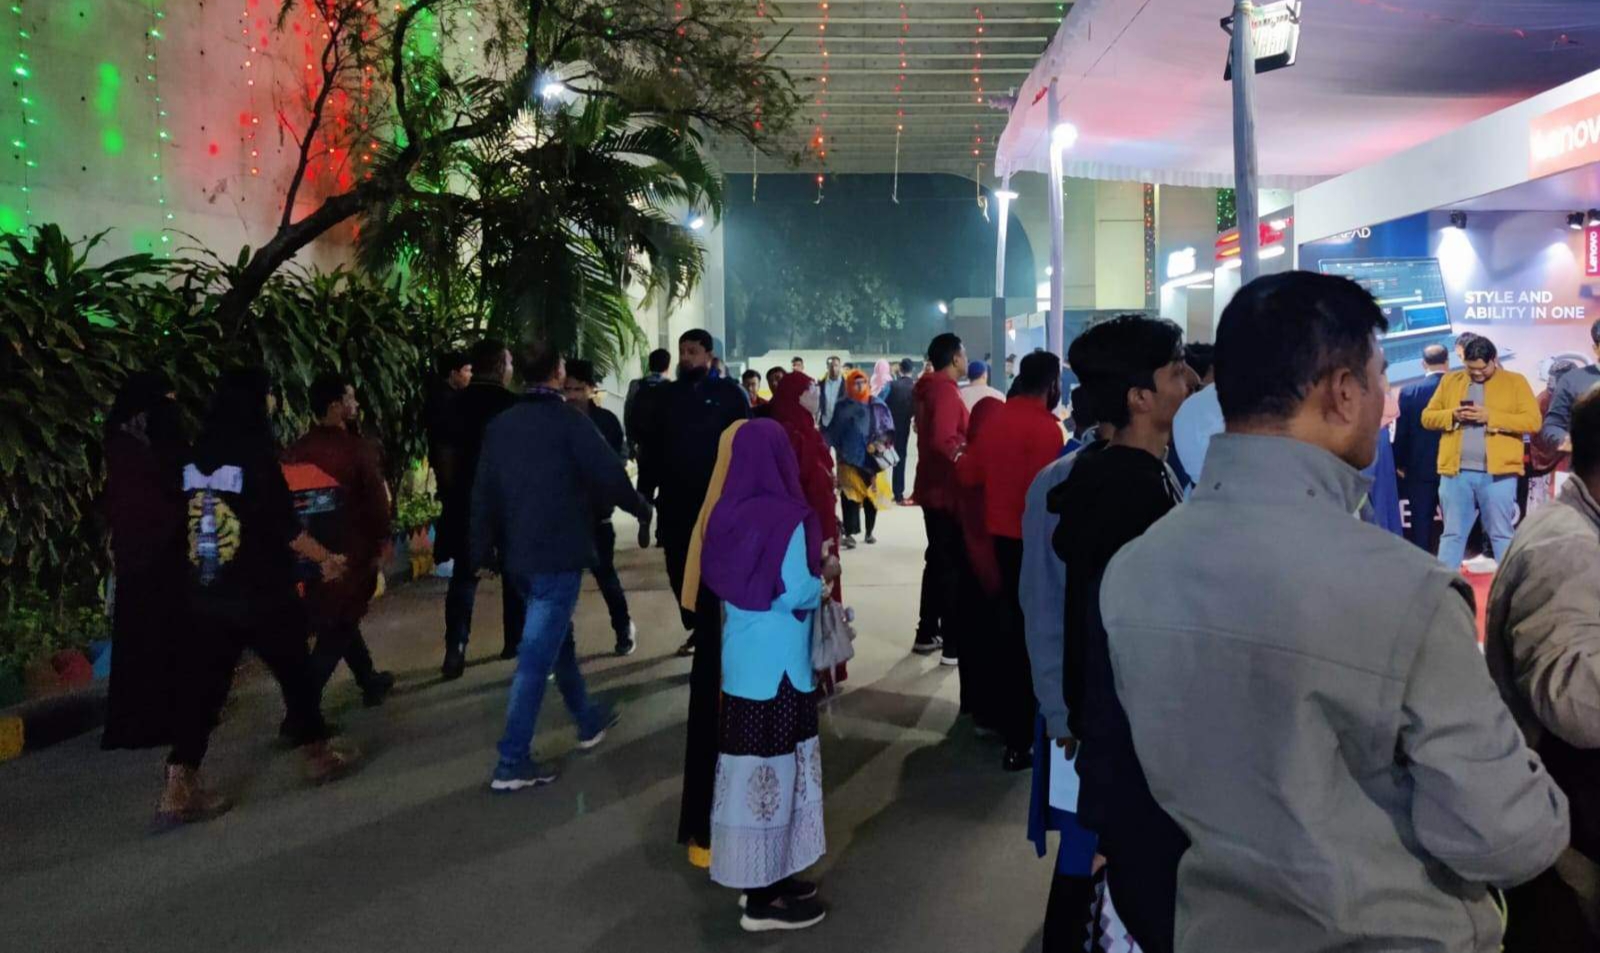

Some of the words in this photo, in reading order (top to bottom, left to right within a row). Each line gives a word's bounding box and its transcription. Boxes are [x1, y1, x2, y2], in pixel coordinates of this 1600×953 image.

[1531, 114, 1600, 160] nov
[1464, 290, 1514, 303] STYLE
[1518, 290, 1553, 303] AND
[1464, 306, 1526, 319] ABILITY
[1531, 306, 1547, 319] IN
[1551, 306, 1585, 319] ONE
